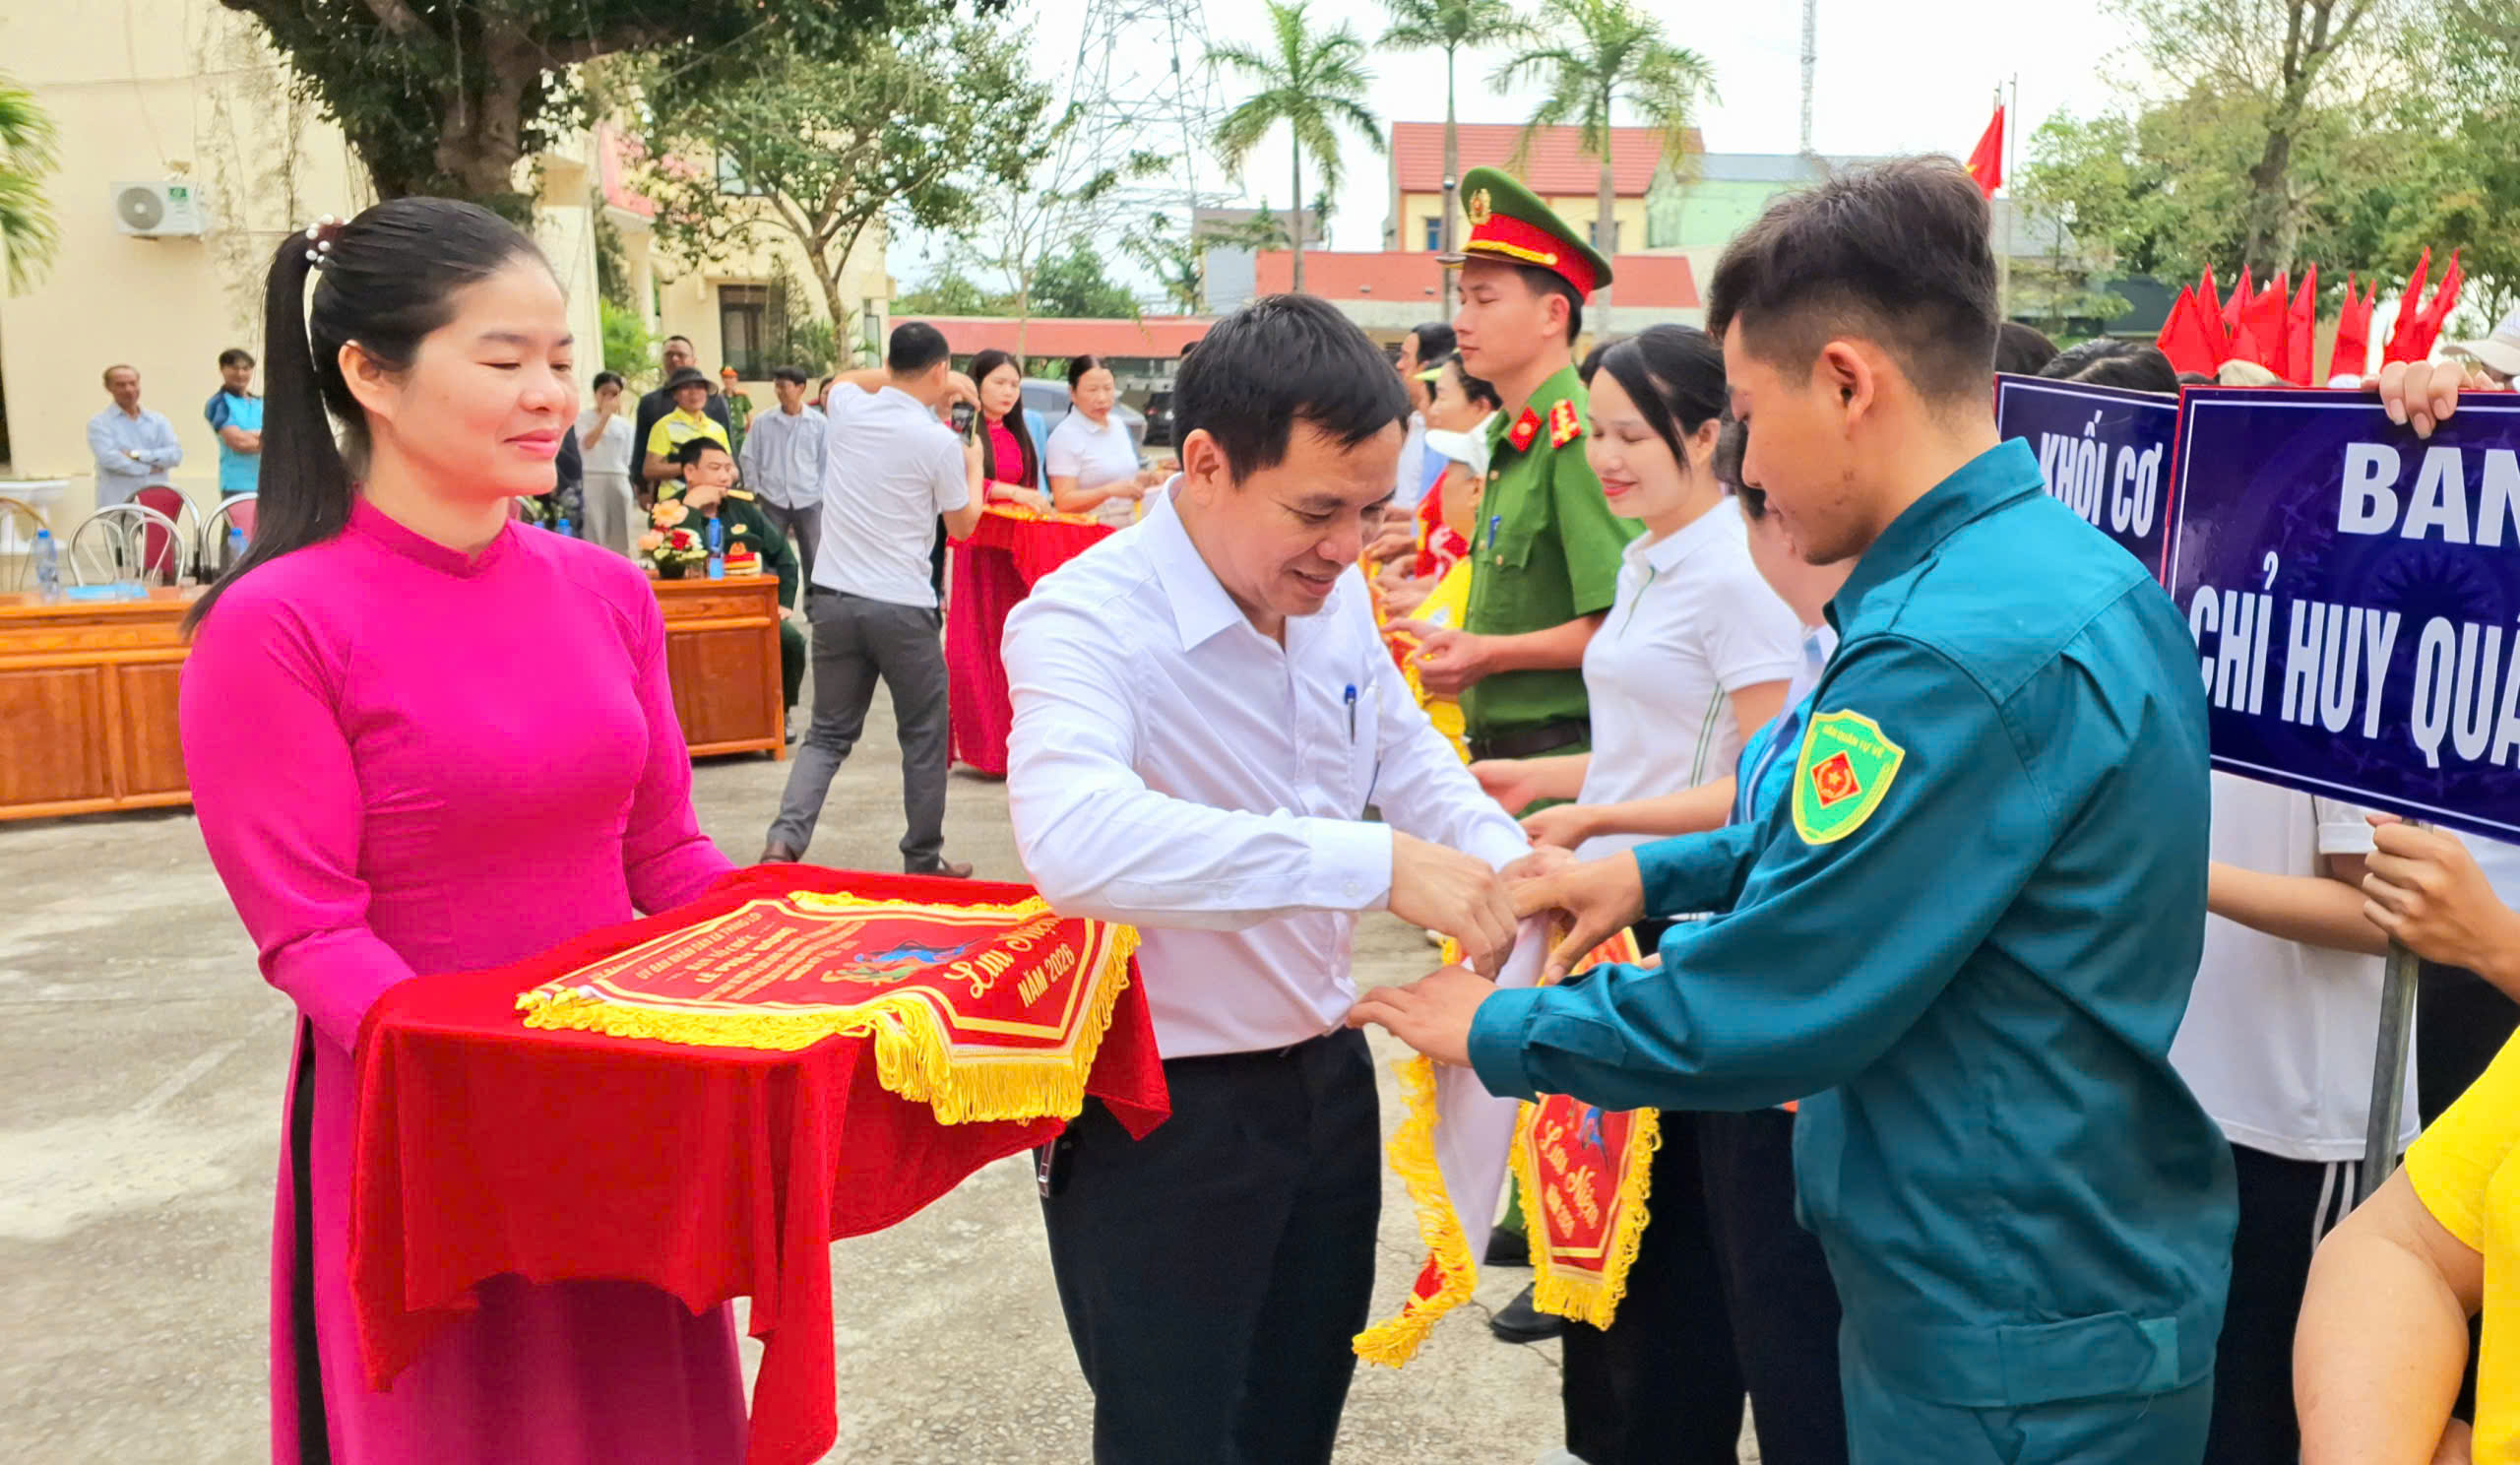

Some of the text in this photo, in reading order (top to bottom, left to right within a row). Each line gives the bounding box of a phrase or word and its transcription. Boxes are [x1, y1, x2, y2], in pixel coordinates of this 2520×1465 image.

[2040, 410, 2163, 538] KHỐI CƠ
[2338, 442, 2520, 547] BAN
[2189, 551, 2278, 715] CHỈ
[2281, 599, 2401, 739] HUY
[1016, 964, 1048, 1008] NĂM
